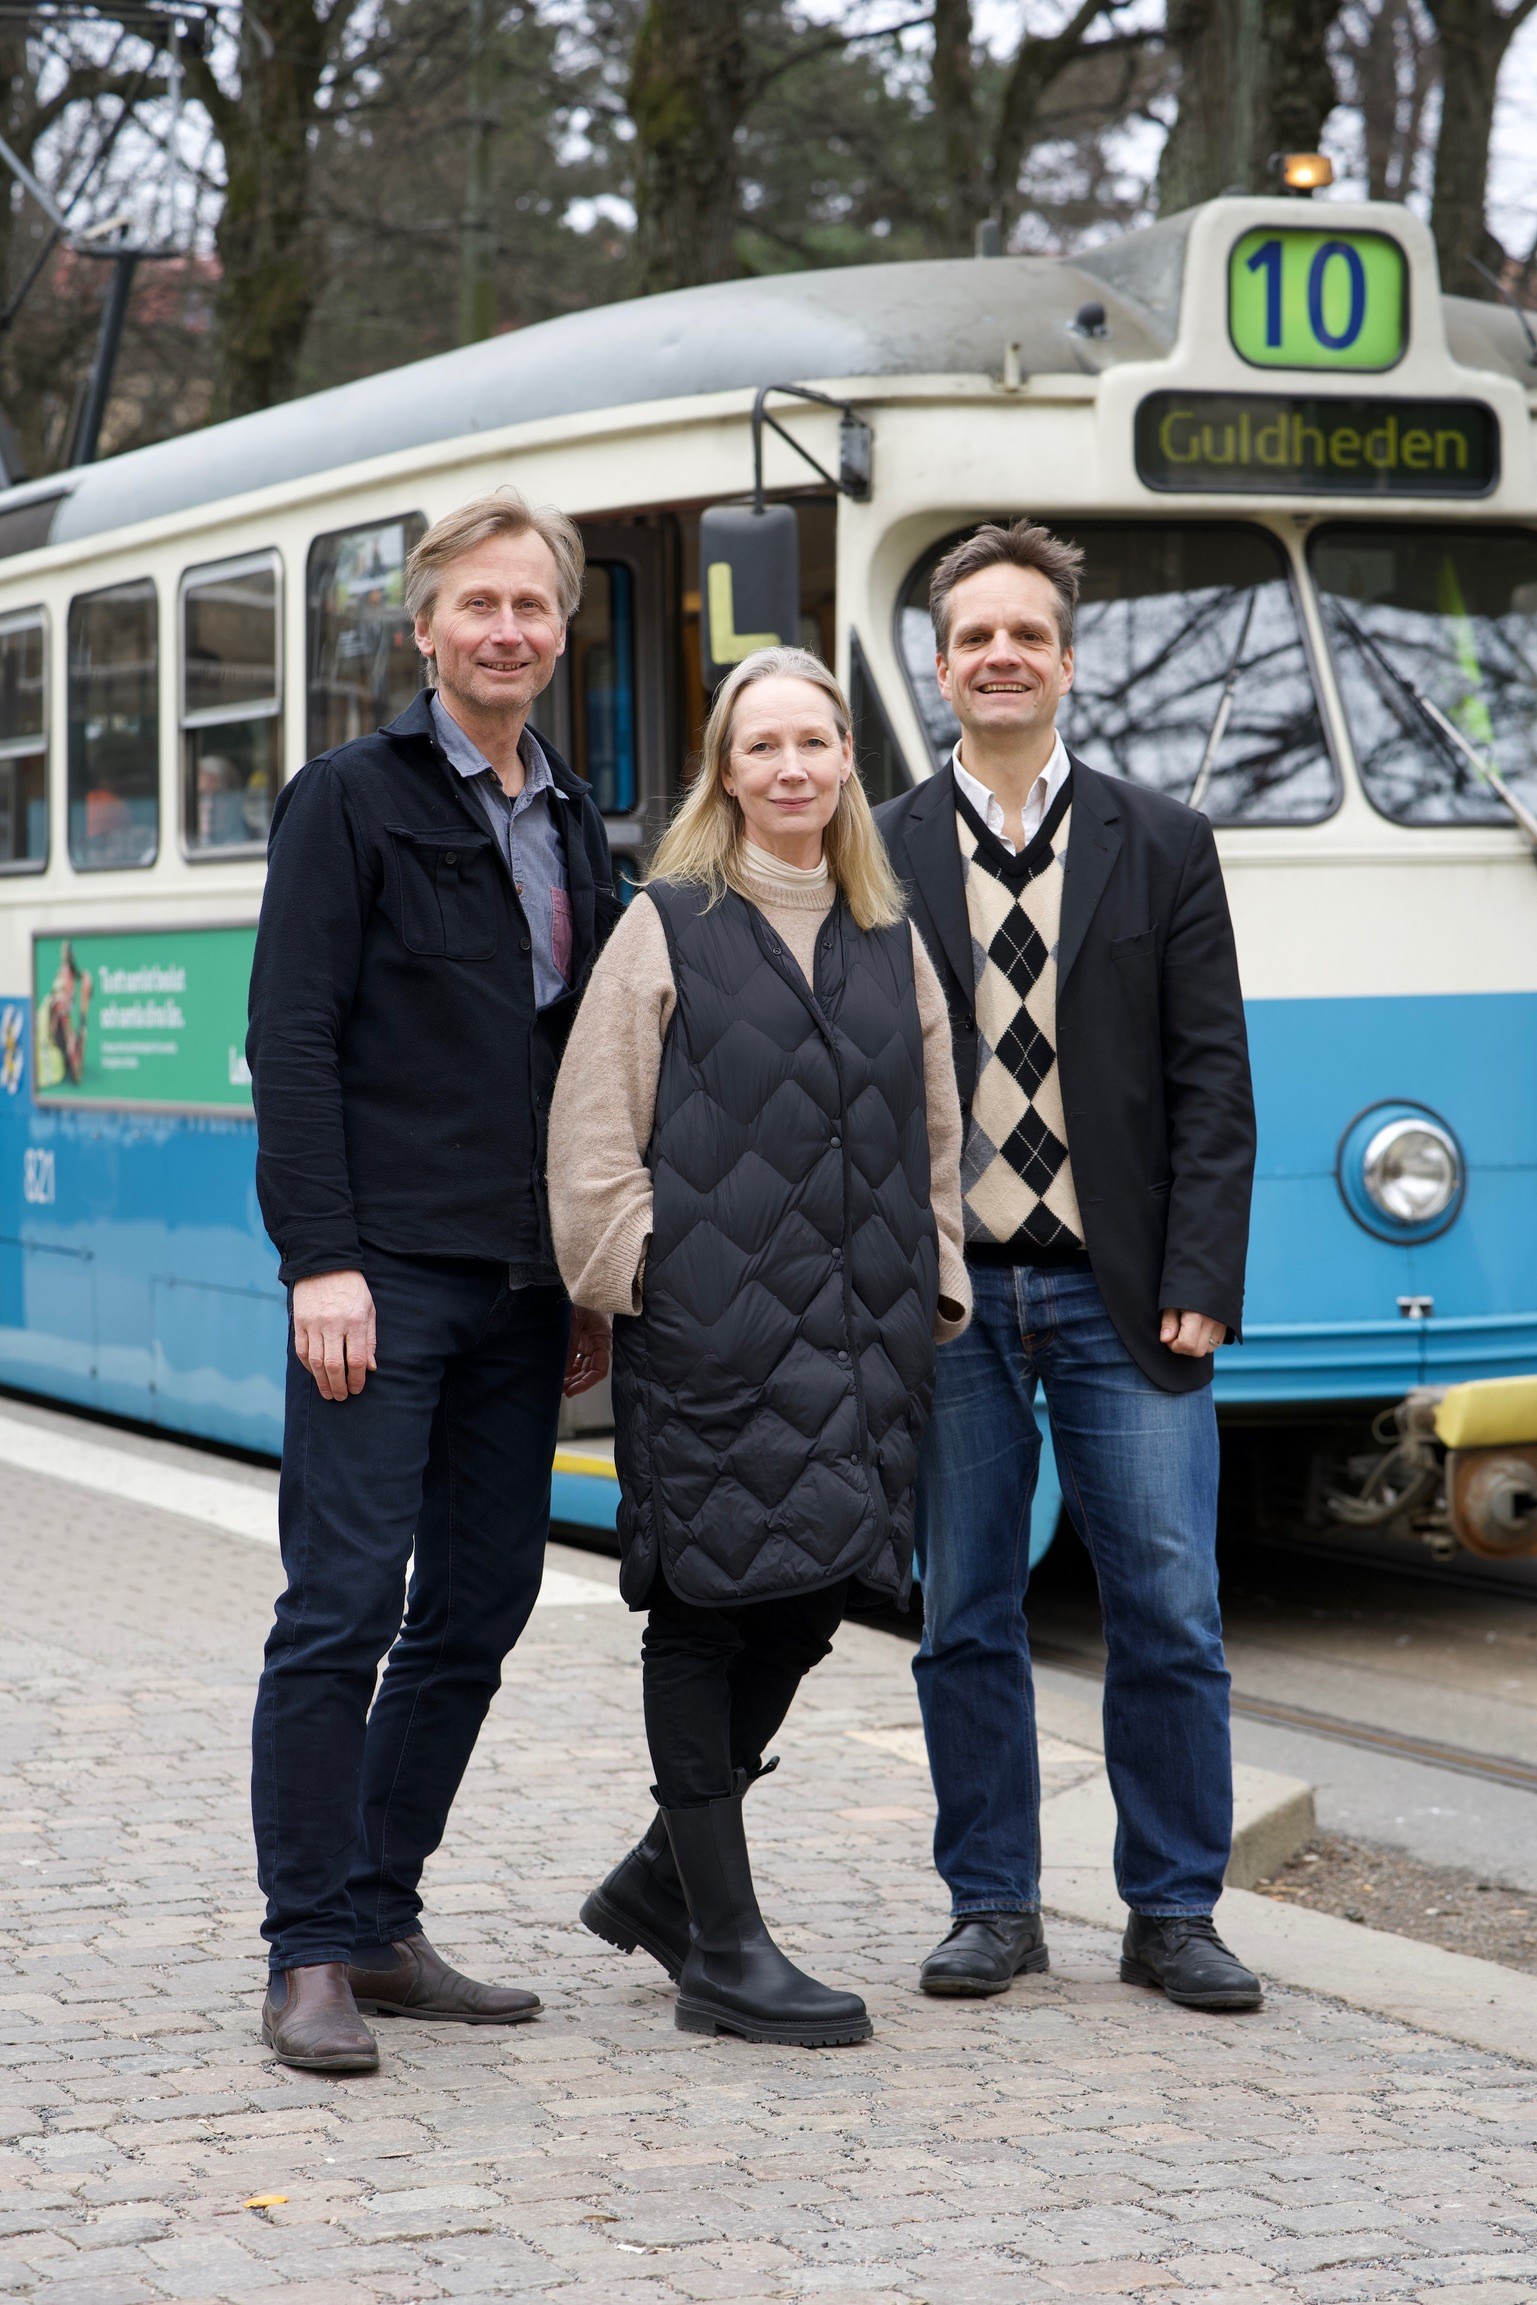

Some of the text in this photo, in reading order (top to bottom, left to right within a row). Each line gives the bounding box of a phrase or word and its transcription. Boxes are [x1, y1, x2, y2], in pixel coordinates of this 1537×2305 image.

[1246, 239, 1367, 351] 10
[1159, 410, 1469, 470] Guldheden
[24, 1147, 55, 1205] 821
